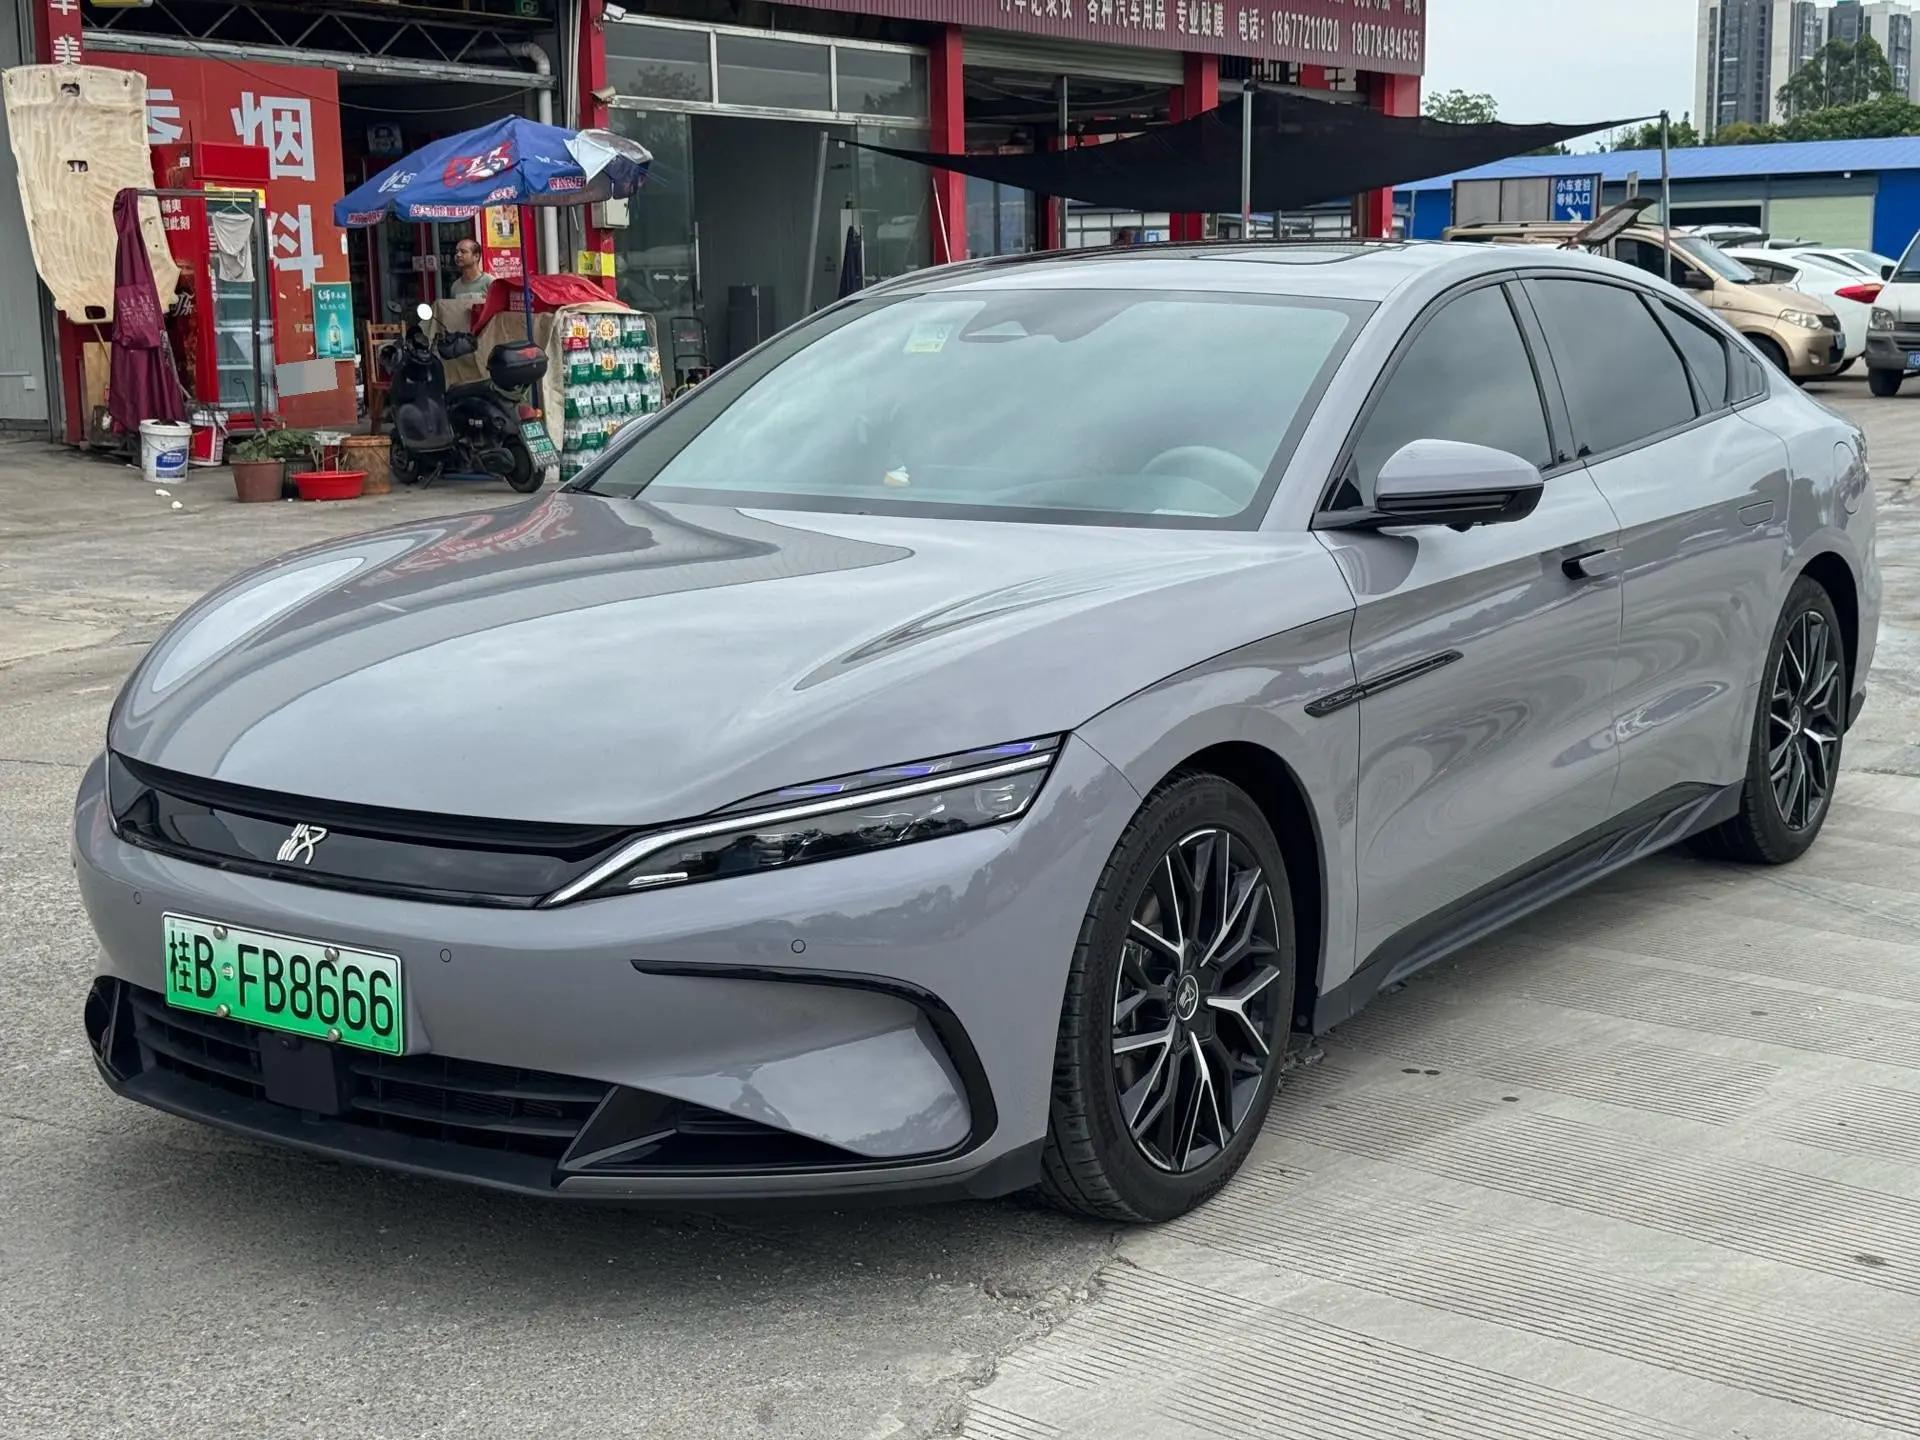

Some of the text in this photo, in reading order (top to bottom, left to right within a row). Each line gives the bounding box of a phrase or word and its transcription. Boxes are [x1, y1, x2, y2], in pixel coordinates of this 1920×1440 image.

[1086, 0, 1166, 31] 各种汽车用品
[1176, 1, 1225, 38] 专业贴膜
[1271, 11, 1340, 52] 18677211020
[1351, 22, 1420, 62] 18078494635
[1556, 179, 1591, 192] 小车查验
[1556, 193, 1590, 206] 等候入口
[169, 929, 395, 1037] 桂B FB8666
